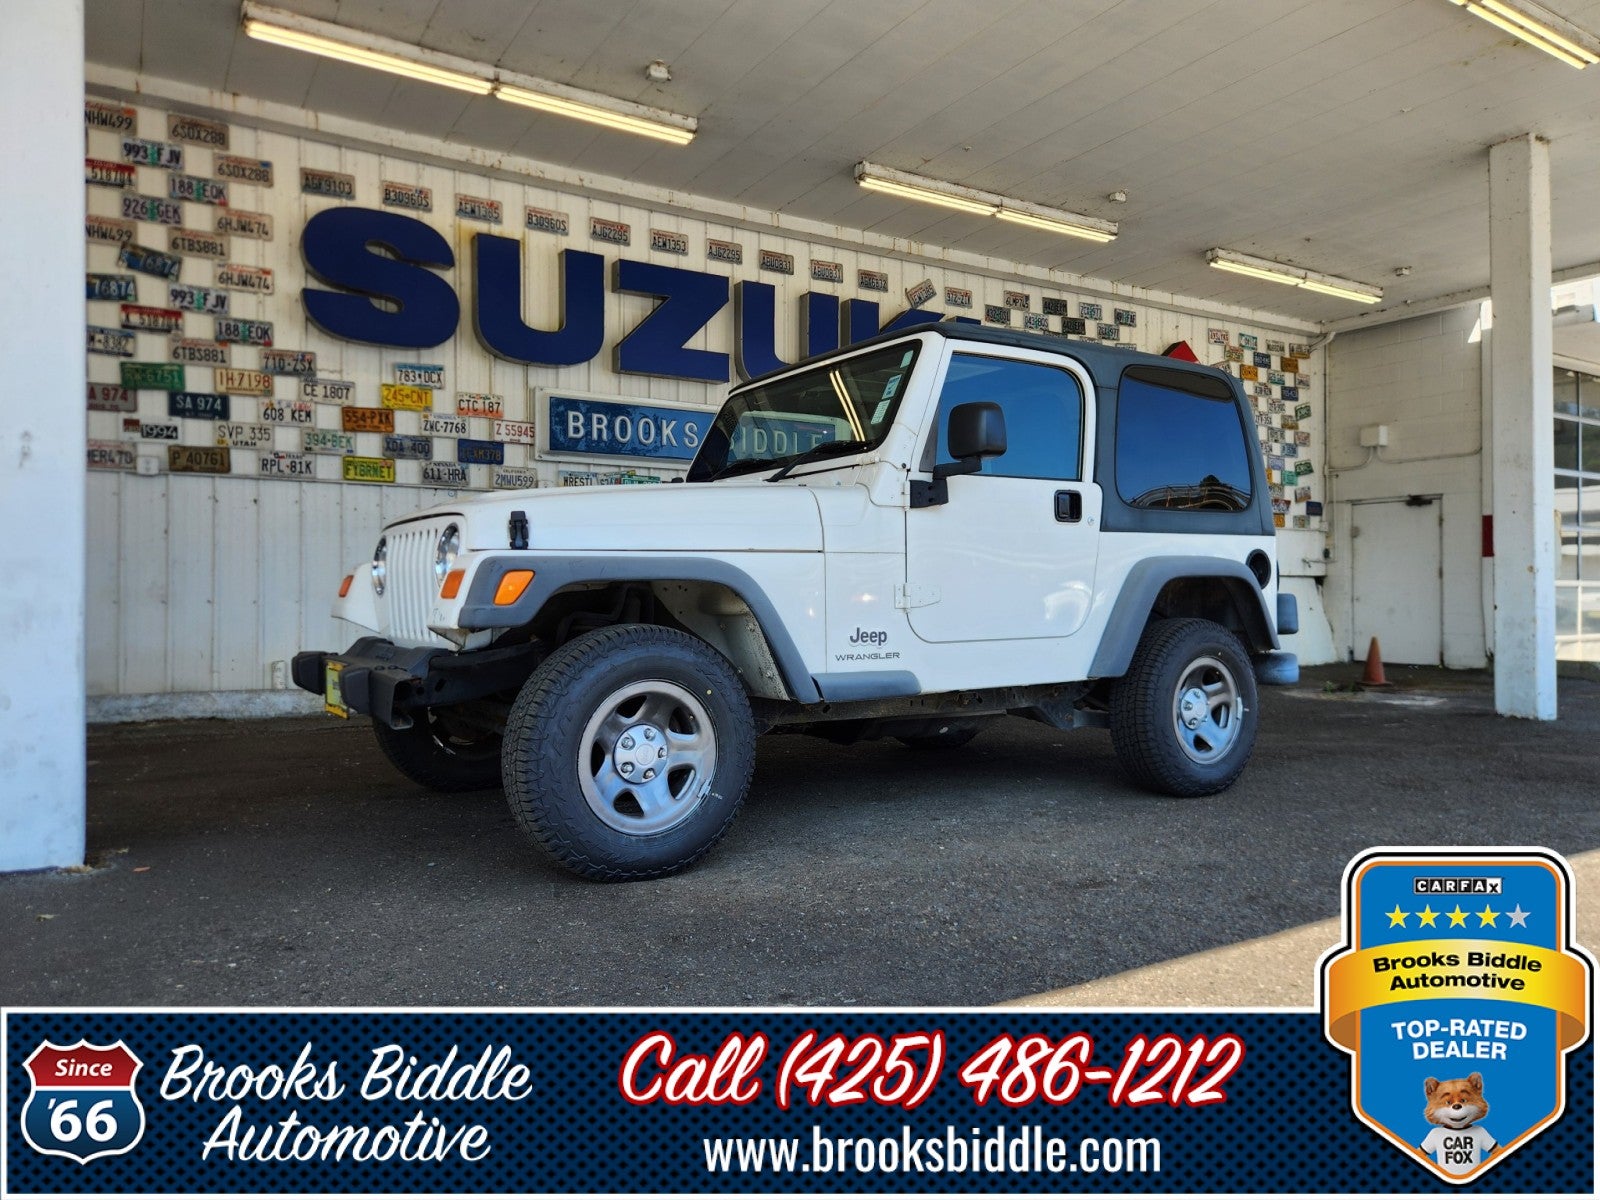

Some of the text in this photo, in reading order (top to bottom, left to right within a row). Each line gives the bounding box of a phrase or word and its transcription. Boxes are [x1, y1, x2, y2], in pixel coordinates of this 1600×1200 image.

[171, 179, 194, 195] 188
[123, 197, 148, 214] 926
[170, 288, 195, 306] 993
[218, 321, 240, 337] 188
[172, 346, 227, 363] 6TBS881
[323, 386, 351, 400] 1807
[175, 394, 222, 412] SA 974
[458, 399, 501, 414] CTC 187
[263, 408, 285, 421] 608
[142, 424, 178, 439] 1994
[218, 424, 272, 442] SVP 335
[505, 424, 535, 438] 55945
[566, 410, 700, 448] BROOKS
[849, 626, 888, 647] Jeep
[834, 651, 902, 662] WRANGLER
